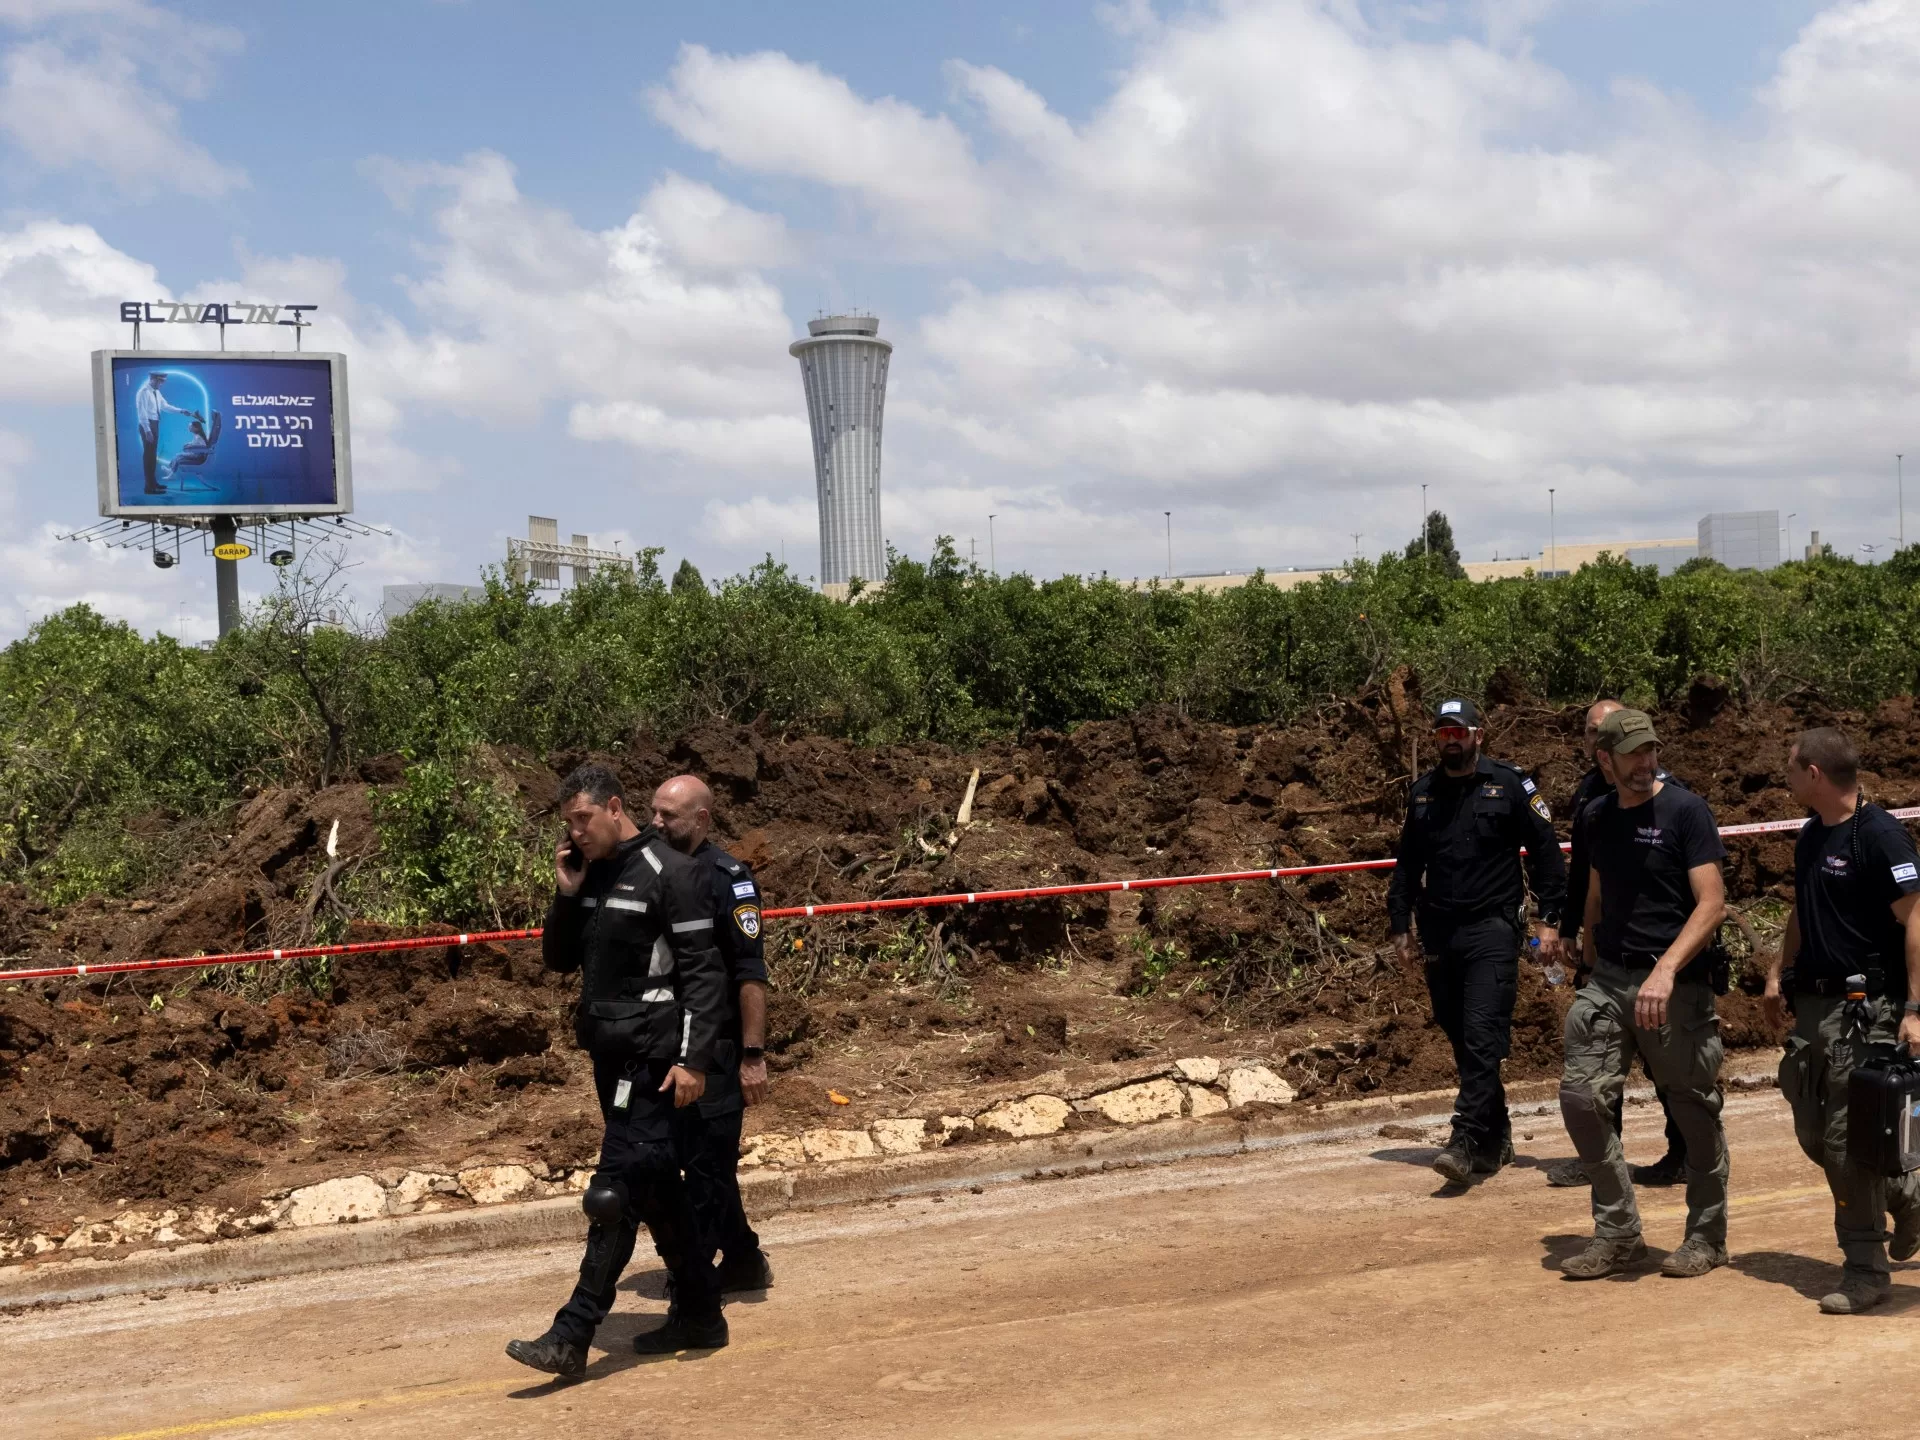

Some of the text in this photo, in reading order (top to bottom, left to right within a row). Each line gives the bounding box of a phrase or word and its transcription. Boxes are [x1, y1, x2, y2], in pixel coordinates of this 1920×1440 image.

[235, 415, 313, 430] הכי בבית
[246, 432, 304, 448] בעולם
[218, 548, 246, 556] BARAM
